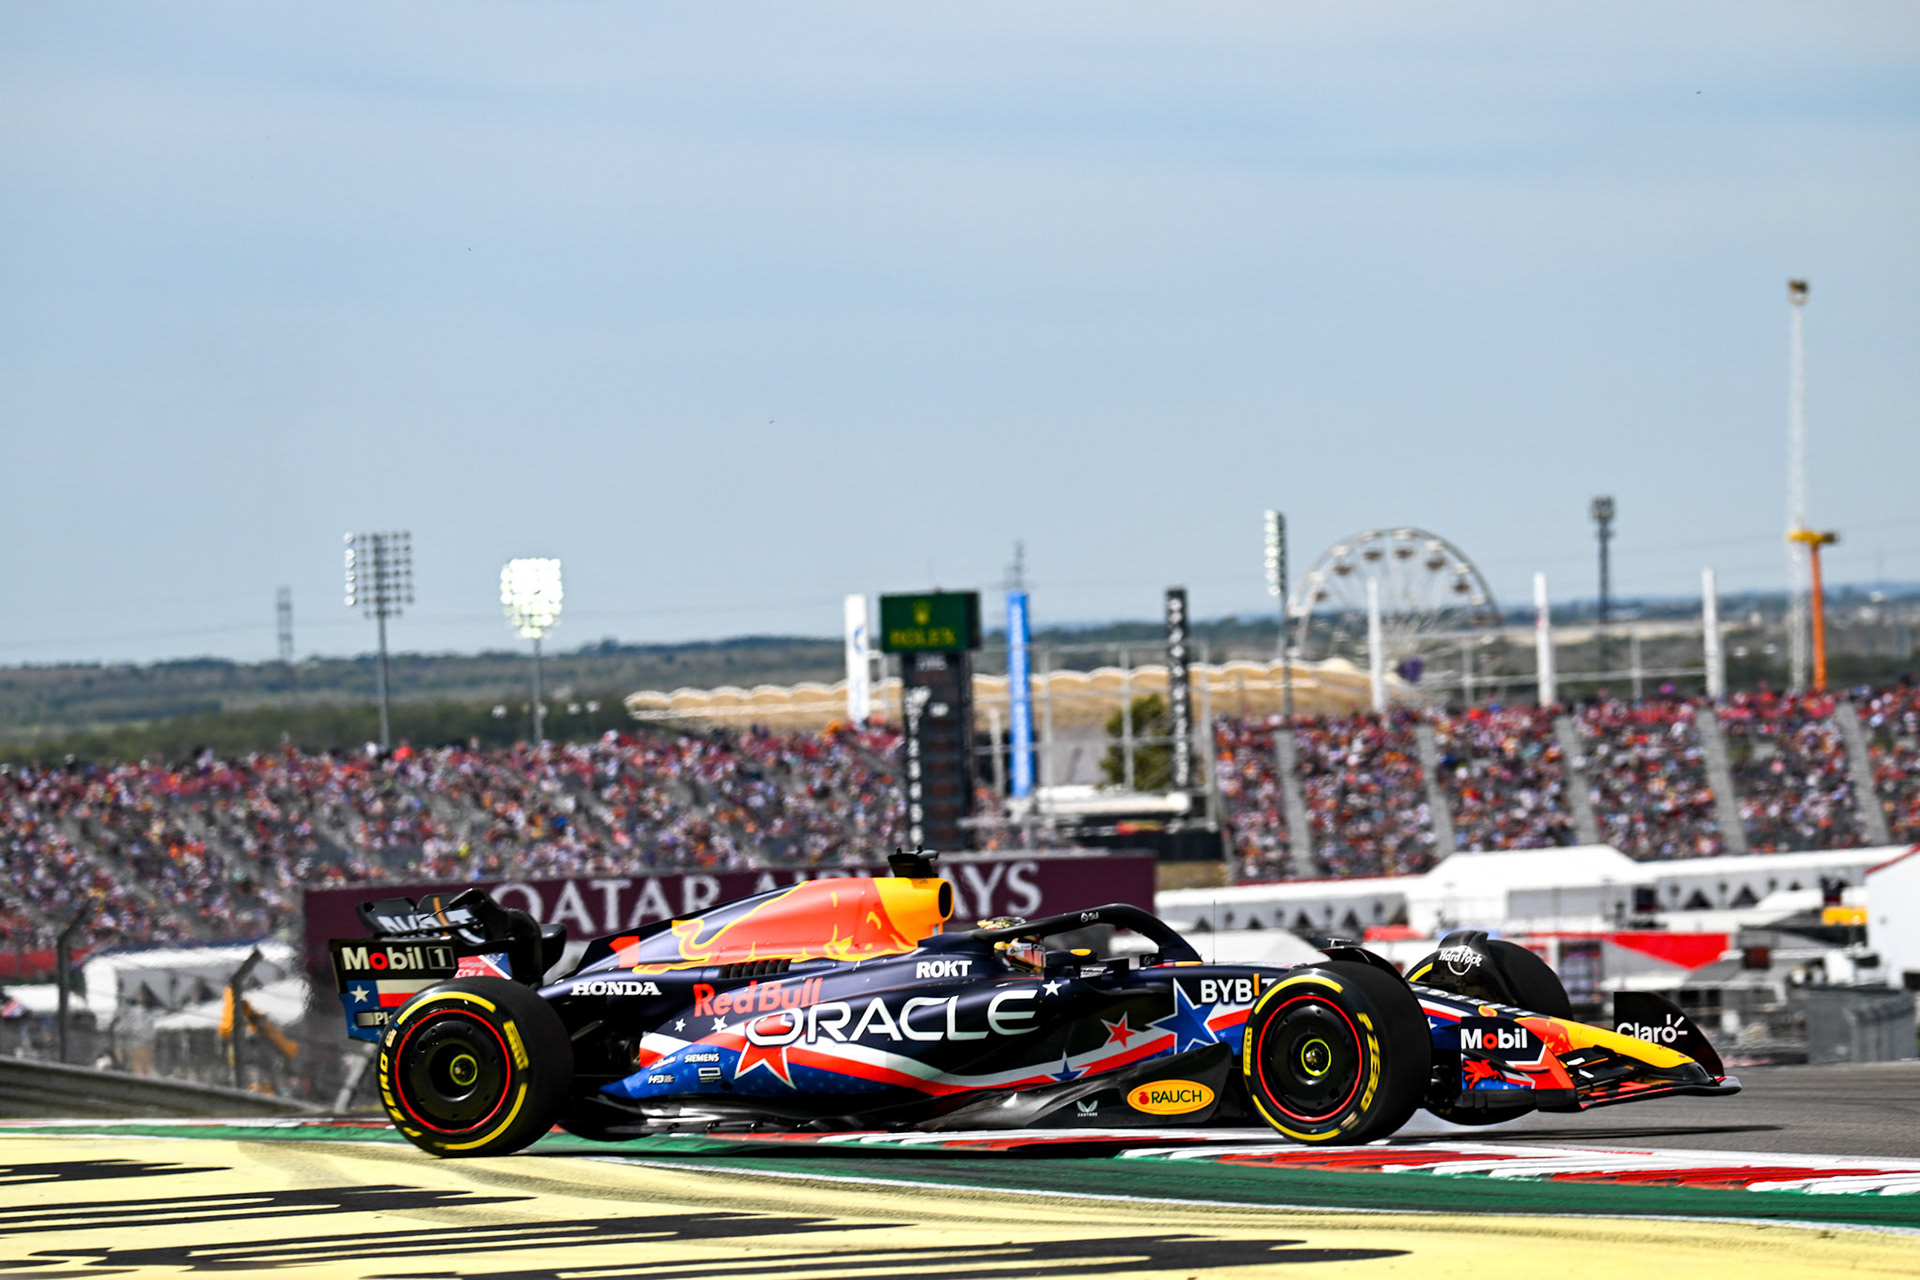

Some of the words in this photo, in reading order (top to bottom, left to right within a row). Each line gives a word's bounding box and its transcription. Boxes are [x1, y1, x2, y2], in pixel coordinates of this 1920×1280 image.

[341, 947, 424, 970] Mobil
[916, 960, 973, 979] ROKT
[570, 981, 662, 996] HONDA
[692, 981, 758, 1017] Red
[758, 977, 824, 1012] Bull
[745, 989, 1040, 1047] ORACLE
[1616, 1014, 1688, 1043] Claro
[1460, 1028, 1528, 1049] Mobil
[684, 1053, 720, 1063] SIEMENS
[1360, 1033, 1381, 1112] ZERO
[1151, 1089, 1202, 1104] RAUCH
